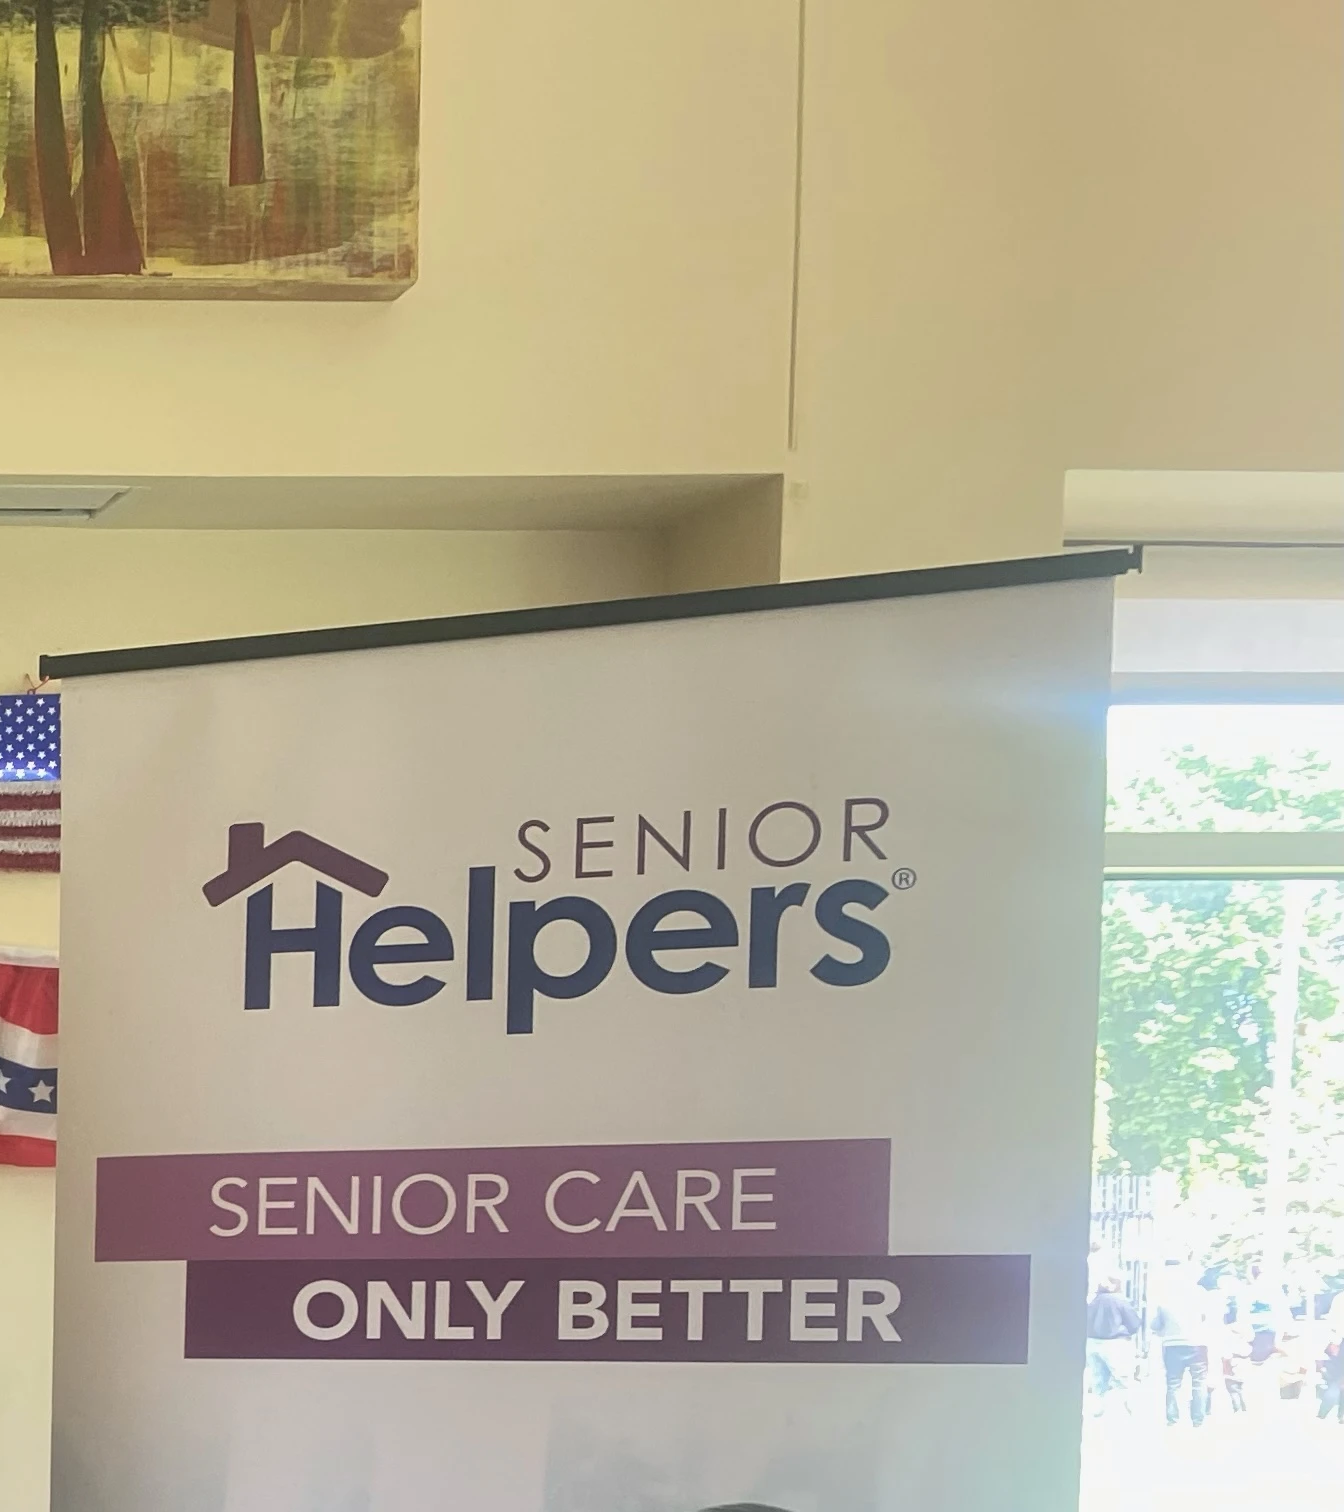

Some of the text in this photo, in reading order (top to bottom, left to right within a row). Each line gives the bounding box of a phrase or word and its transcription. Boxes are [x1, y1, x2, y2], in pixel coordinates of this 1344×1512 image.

[514, 797, 890, 883] SENIOR
[209, 1167, 778, 1239] SENIOR CARE
[292, 1278, 903, 1343] ONLY BETTER
